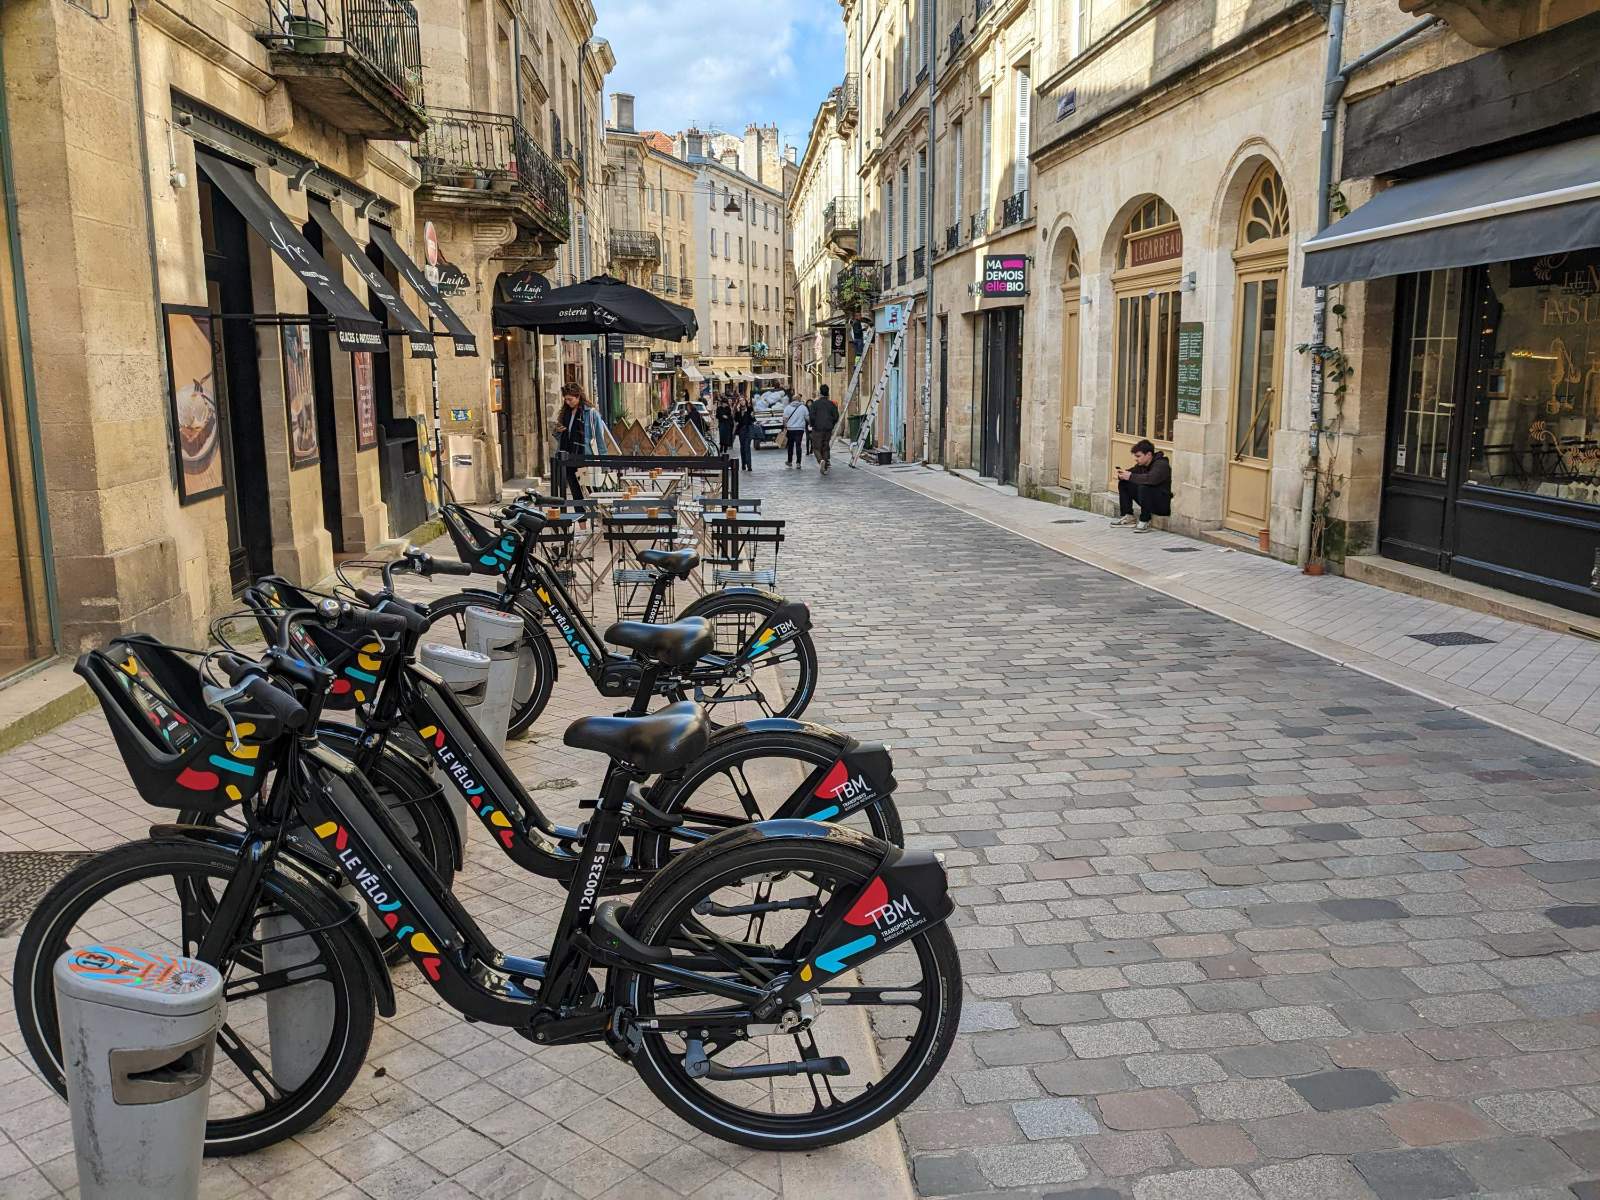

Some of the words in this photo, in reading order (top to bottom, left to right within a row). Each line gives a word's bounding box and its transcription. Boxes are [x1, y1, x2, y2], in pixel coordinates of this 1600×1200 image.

[986, 260, 1002, 270] MA
[439, 271, 466, 291] Luigi
[986, 271, 1024, 280] DEMOIS
[524, 284, 543, 298] Luigi
[559, 307, 587, 317] osteria
[549, 604, 559, 616] LE
[772, 619, 798, 636] TBM
[437, 746, 455, 763] LE
[450, 760, 474, 789] VÉLO
[830, 774, 872, 802] TBM
[338, 848, 362, 871] LE
[355, 867, 388, 904] VÉLO
[579, 855, 606, 912] 1200235
[864, 894, 920, 930] TBM
[881, 917, 914, 938] TRANSPORTS
